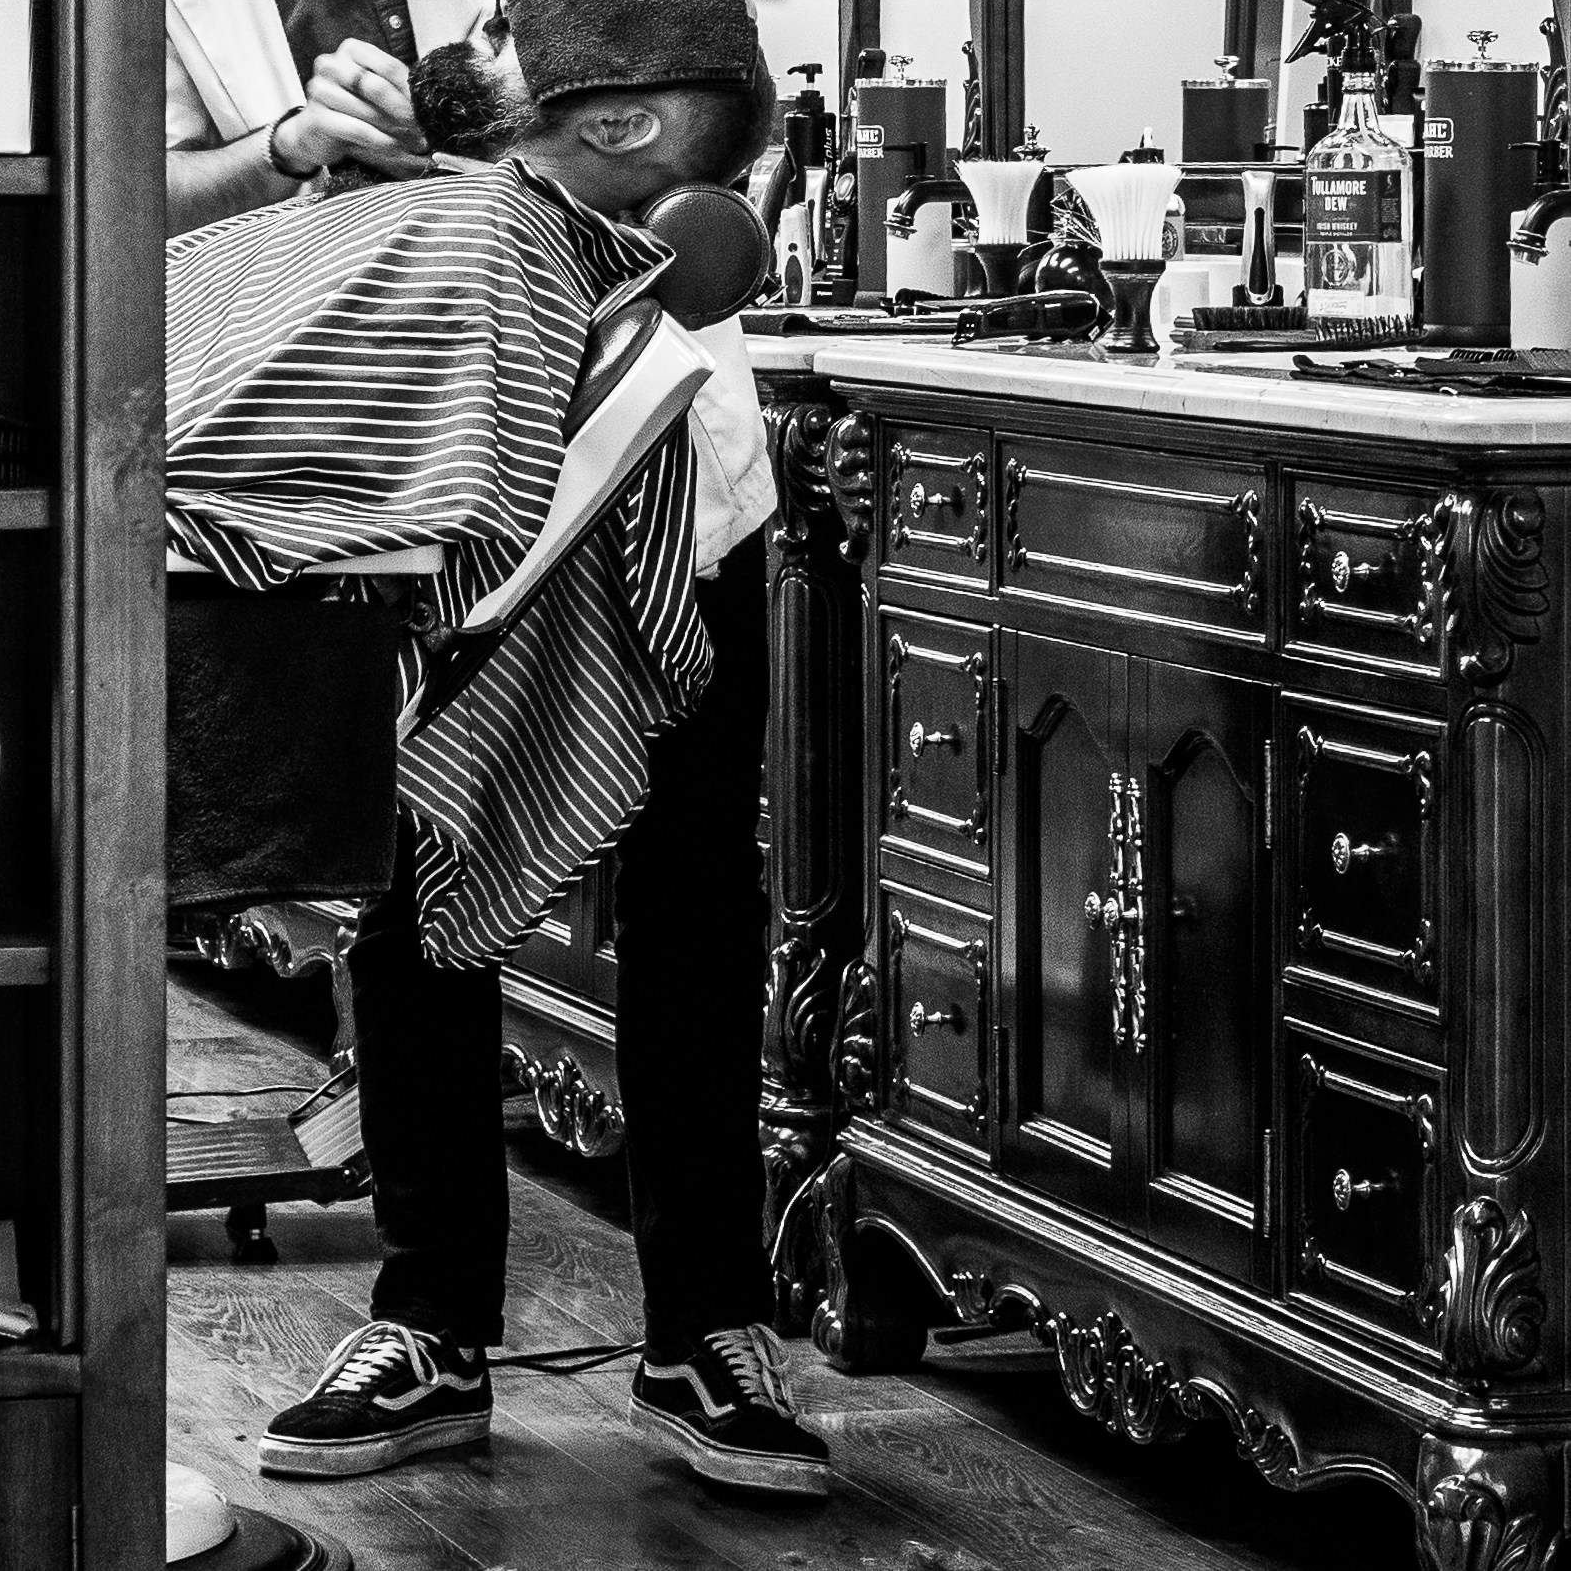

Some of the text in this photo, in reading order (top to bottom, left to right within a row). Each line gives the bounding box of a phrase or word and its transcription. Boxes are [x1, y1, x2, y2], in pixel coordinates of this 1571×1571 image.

[1310, 176, 1367, 196] TULLAMORE
[1324, 196, 1348, 212] DEW
[1331, 222, 1358, 231] WHISKEY
